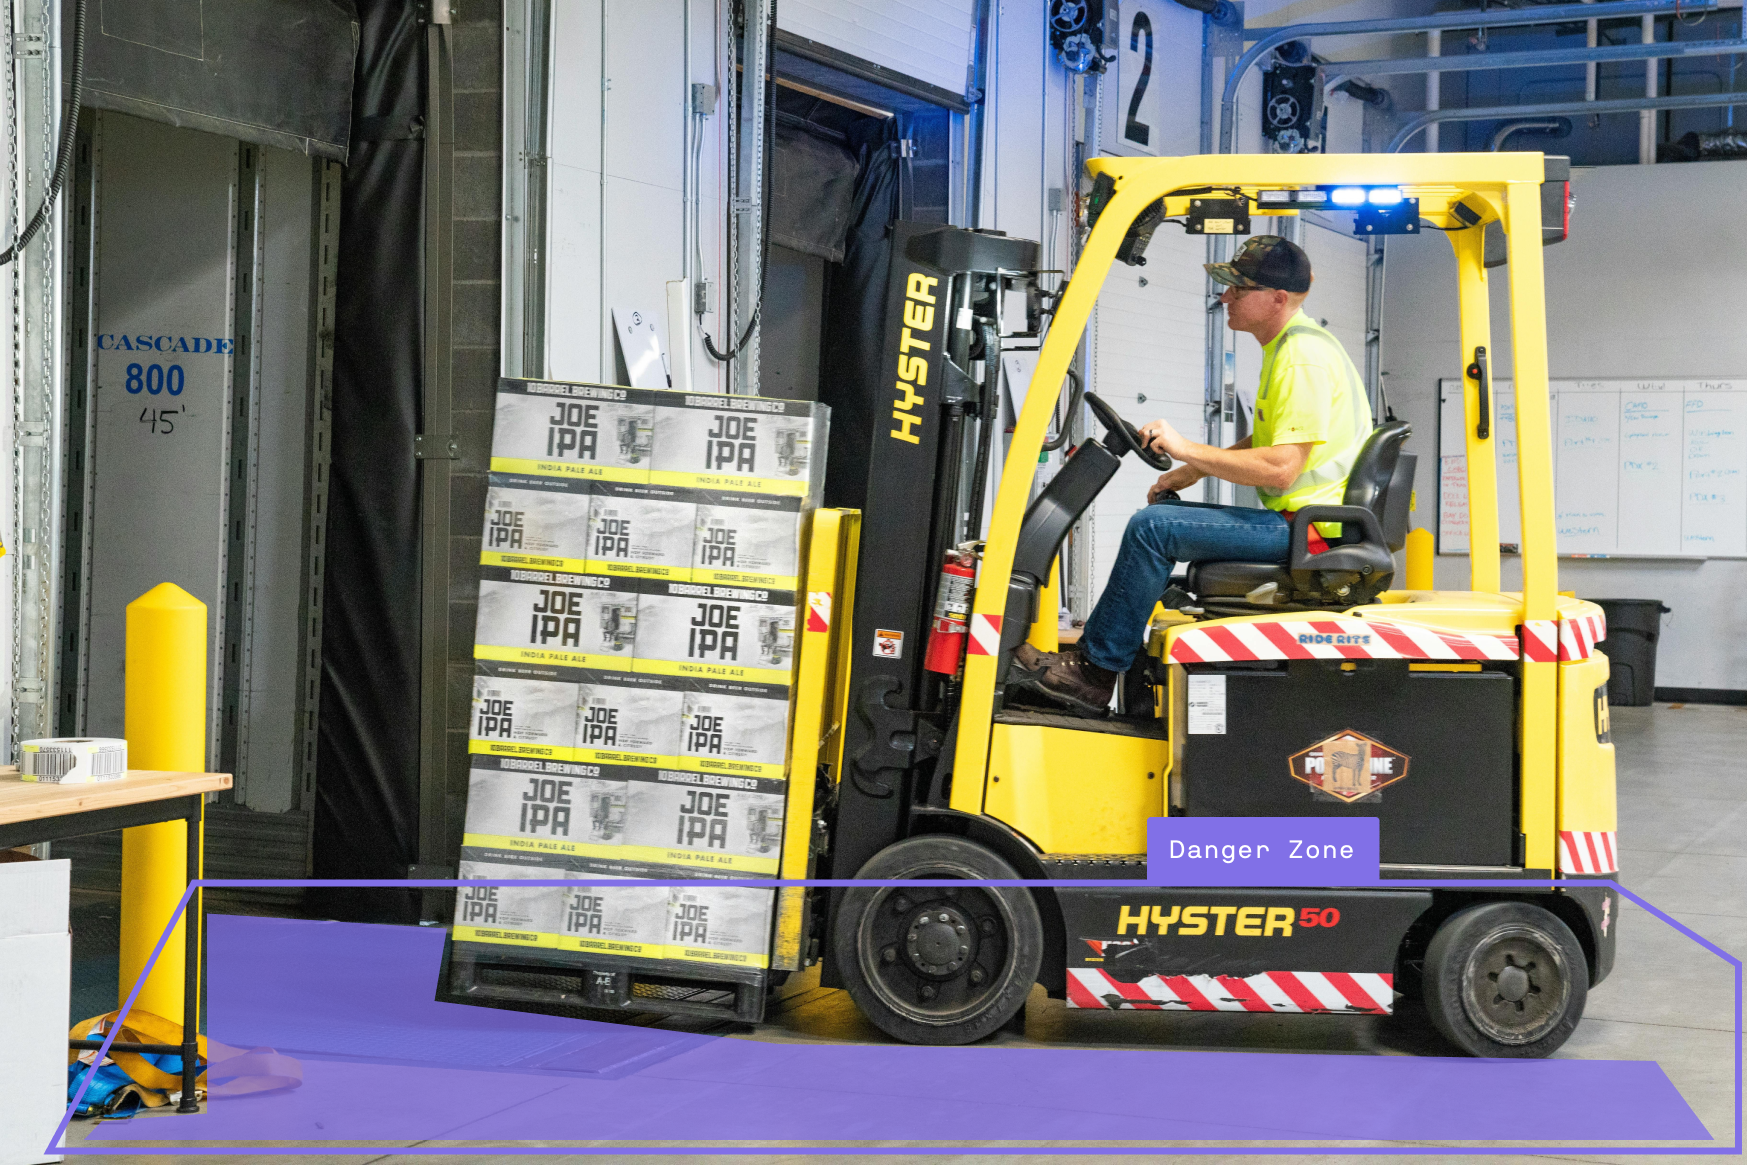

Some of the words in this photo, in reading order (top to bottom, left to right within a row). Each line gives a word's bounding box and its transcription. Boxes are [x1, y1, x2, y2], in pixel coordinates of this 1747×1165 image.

[1124, 11, 1153, 146] 2
[97, 333, 234, 354] CASCADE
[890, 272, 938, 445] HYSTER
[125, 362, 185, 396] 800
[549, 402, 600, 428] JOE
[708, 414, 758, 441] JOE
[546, 427, 598, 460] IPA
[705, 439, 756, 473] IPA
[537, 463, 562, 472] INDIA
[565, 465, 585, 474] PALE
[589, 467, 603, 476] ALE
[696, 476, 721, 485] INDIA
[724, 479, 743, 487] PALE
[748, 480, 761, 488] ALE
[490, 510, 525, 528] JOE
[596, 518, 631, 536] JOE
[488, 526, 523, 549] IPA
[594, 535, 629, 558] IPA
[703, 527, 737, 545] JOE
[701, 545, 736, 567] IPA
[533, 589, 583, 616] JOE
[691, 603, 741, 629] JOE
[530, 614, 582, 647] IPA
[1298, 634, 1333, 644] RIDE
[688, 628, 739, 661] IPA
[521, 651, 545, 659] INDIA
[549, 653, 568, 661] PALE
[572, 654, 586, 663] ALE
[679, 664, 703, 673] INDIA
[707, 667, 726, 675] PALE
[729, 668, 744, 677] ALE
[480, 698, 514, 717] JOE
[584, 706, 619, 725] JOE
[477, 715, 512, 738] IPA
[582, 724, 617, 746] IPA
[690, 714, 724, 733] JOE
[687, 731, 722, 754] IPA
[522, 777, 573, 804] JOE
[680, 790, 730, 817] JOE
[519, 803, 571, 836] IPA
[676, 815, 728, 849] IPA
[510, 839, 534, 848] INDIA
[538, 842, 557, 850] PALE
[560, 843, 576, 852] ALE
[667, 851, 691, 860] INDIA
[695, 854, 715, 863] PALE
[718, 856, 732, 864] ALE
[465, 886, 499, 902] JOE
[569, 894, 604, 913] JOE
[462, 901, 498, 923] IPA
[567, 911, 602, 934] IPA
[675, 903, 709, 922] JOE
[1116, 905, 1296, 937] HYSTER
[1298, 907, 1341, 928] 50
[672, 921, 707, 944] IPA
